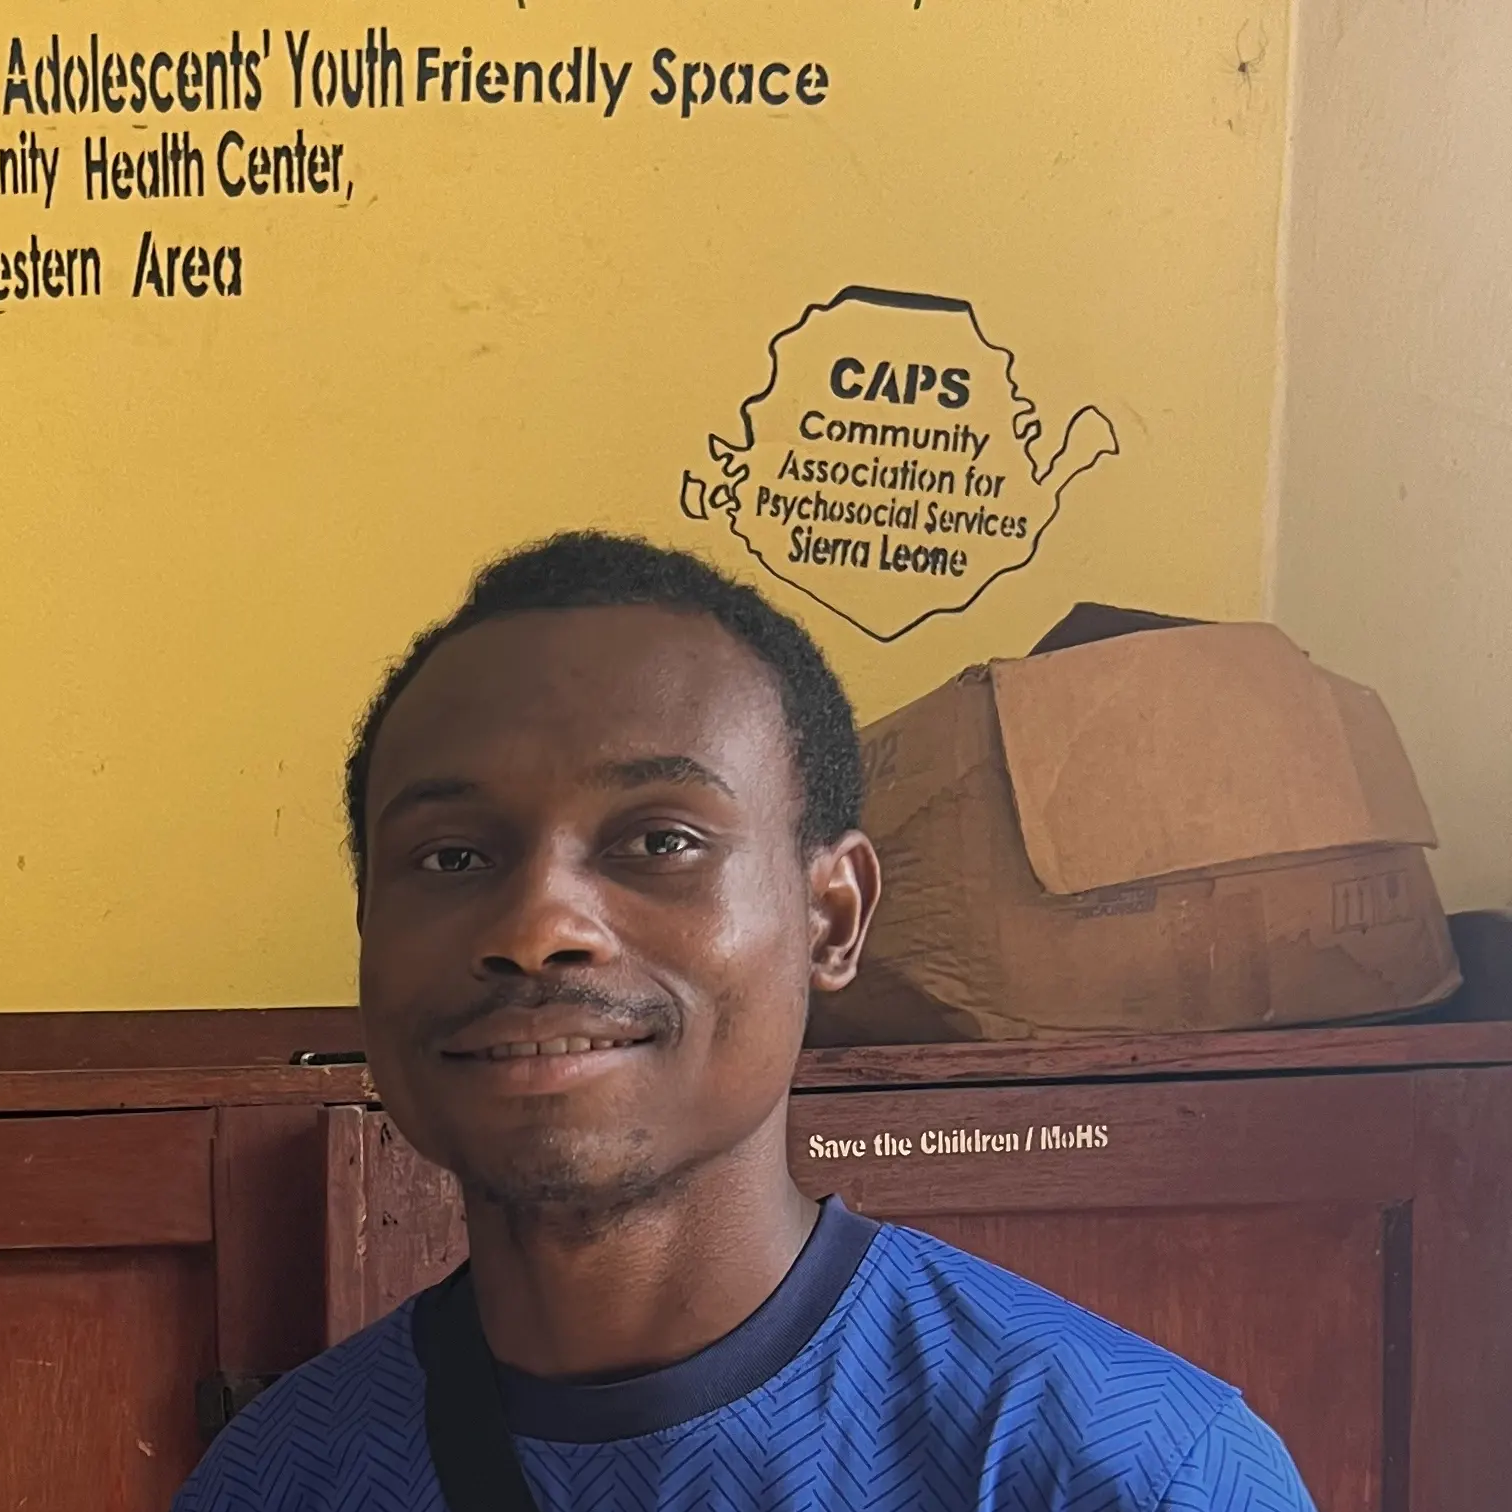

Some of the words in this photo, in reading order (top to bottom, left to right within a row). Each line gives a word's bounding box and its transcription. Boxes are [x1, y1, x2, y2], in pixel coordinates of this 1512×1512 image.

[3, 29, 270, 115] Adolescents'
[285, 27, 404, 109] Youth
[417, 46, 632, 117] Friendly
[650, 47, 829, 118] Space
[85, 131, 204, 200] Health
[217, 129, 353, 200] Center,
[132, 231, 242, 297] Area
[830, 357, 971, 409] CAPS
[799, 410, 990, 461] Community
[778, 450, 954, 493] Association
[965, 466, 1006, 498] for
[756, 486, 919, 529] Psychosocial
[924, 501, 1028, 539] Services
[788, 526, 870, 568] Sierra
[879, 534, 968, 577] Leone
[809, 1134, 866, 1158] Save
[873, 1132, 913, 1156] the
[920, 1129, 1019, 1155] Children
[1040, 1125, 1109, 1150] MoHS
